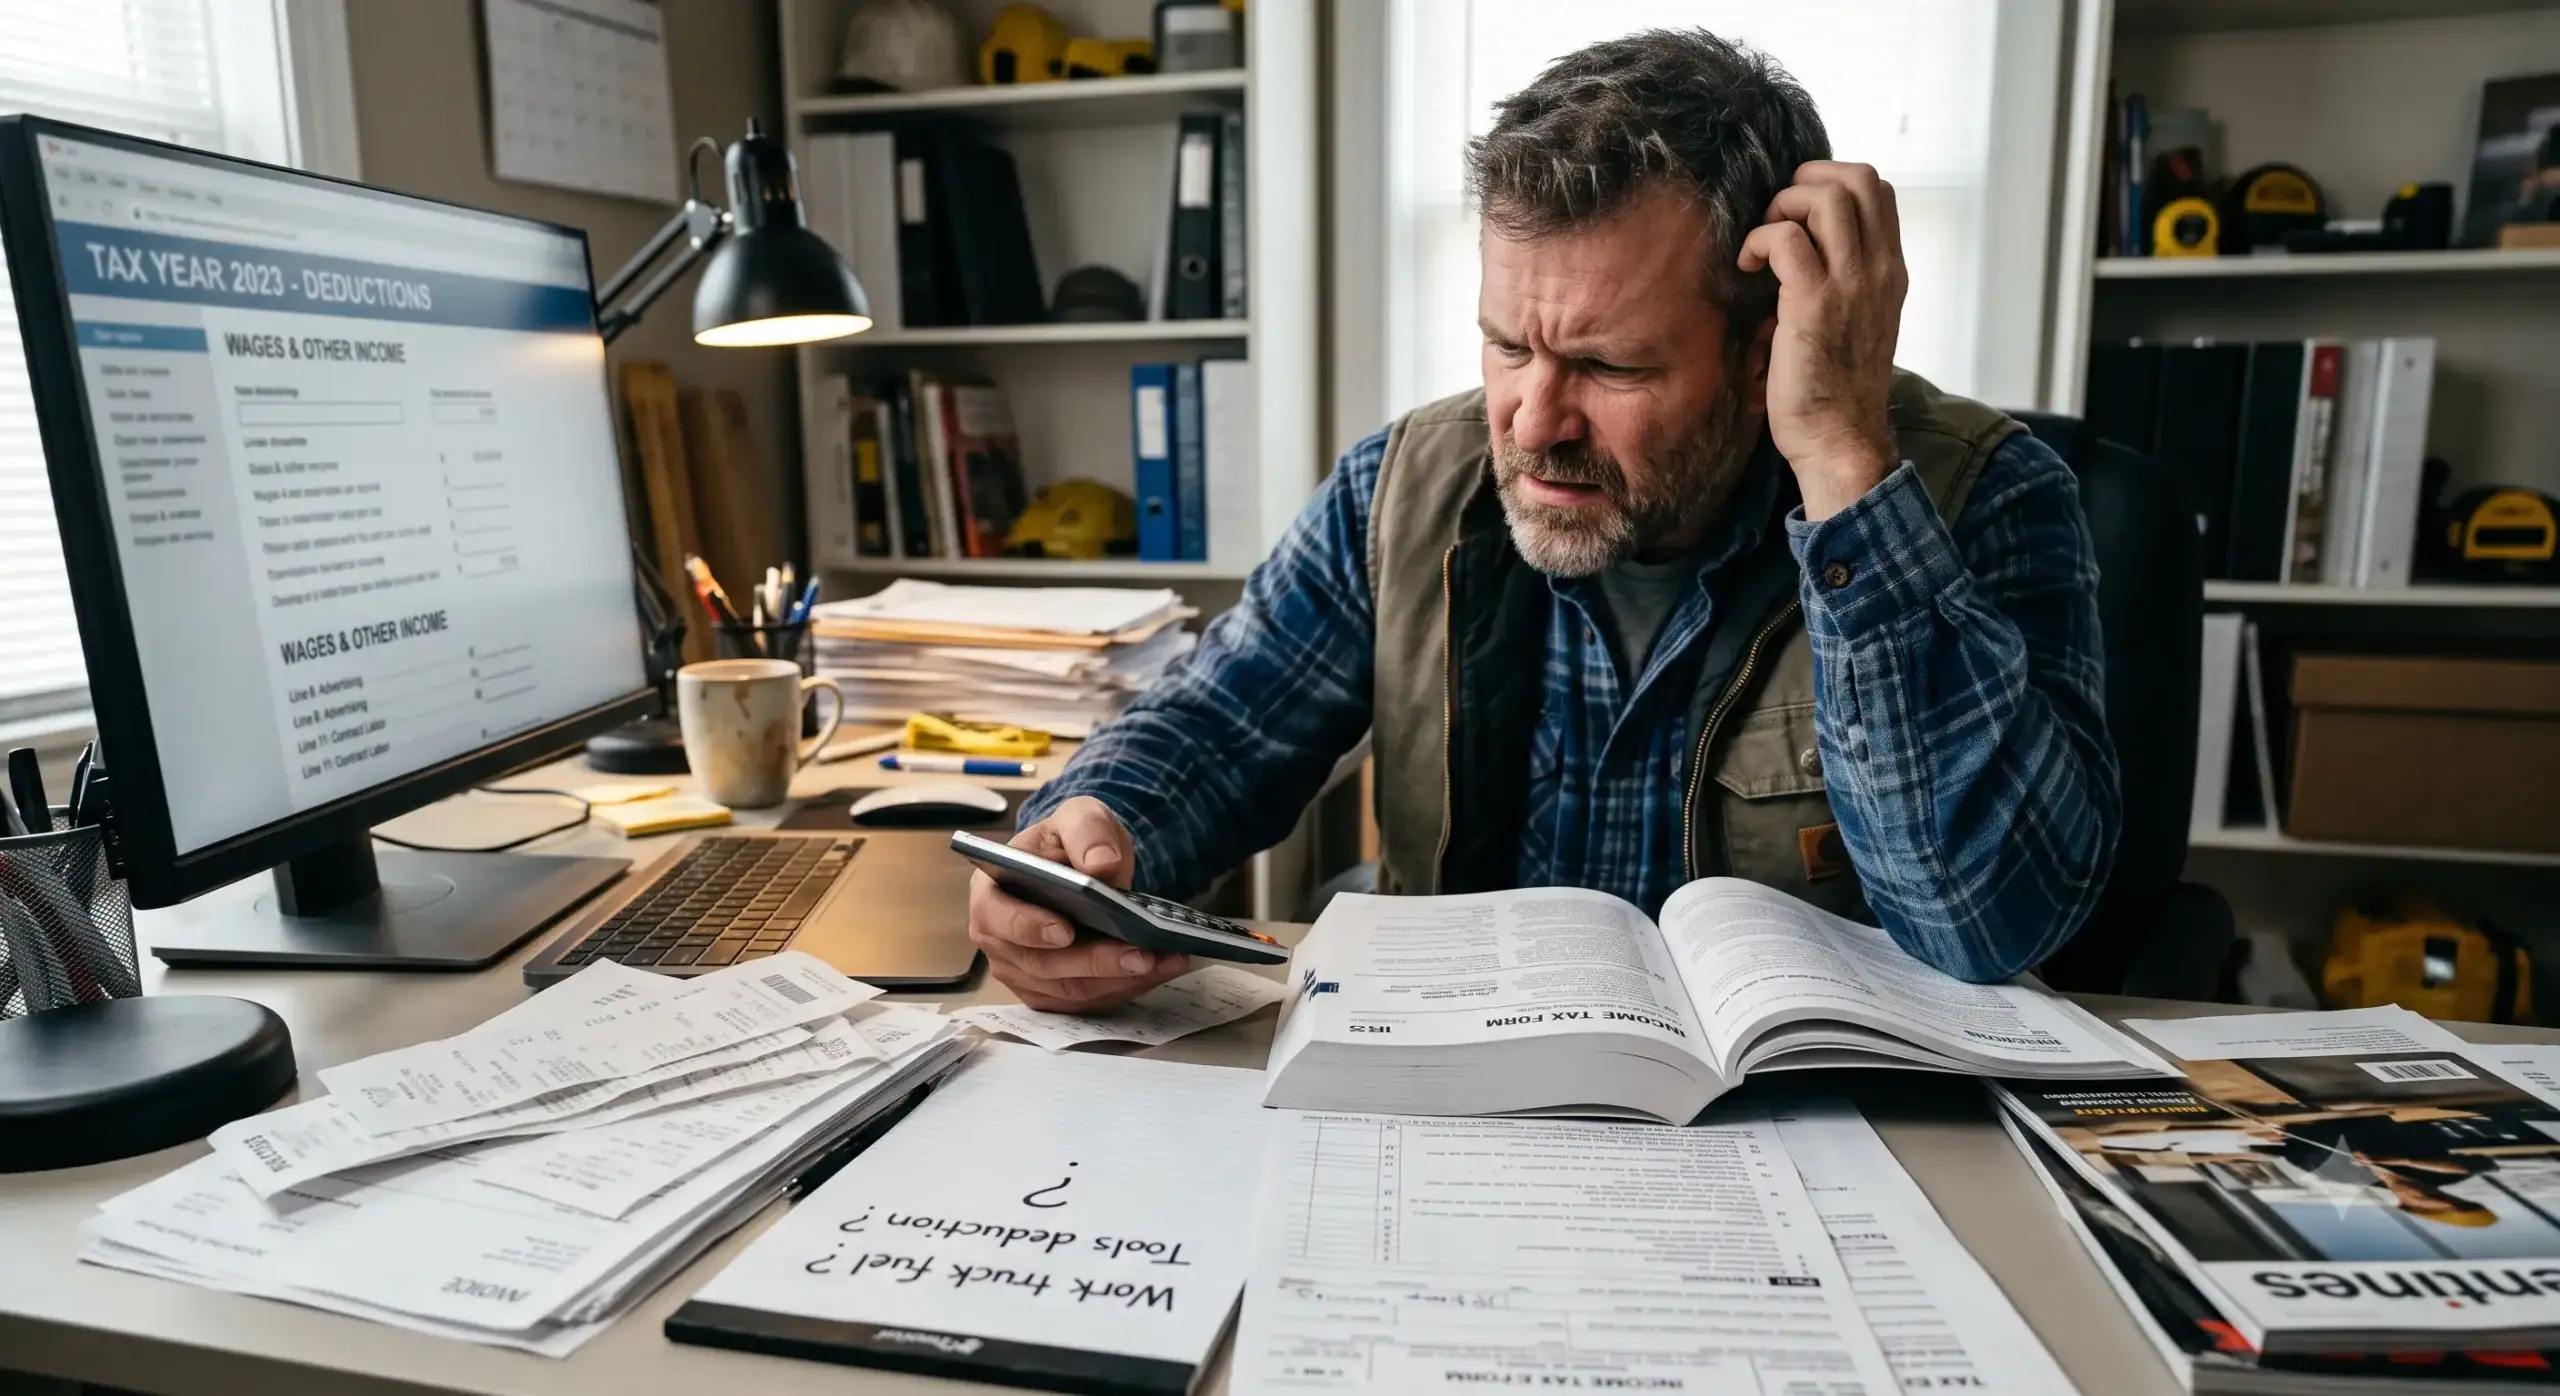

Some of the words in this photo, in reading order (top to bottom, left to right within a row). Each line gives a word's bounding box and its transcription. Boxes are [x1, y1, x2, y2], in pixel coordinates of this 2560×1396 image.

[86, 241, 149, 284] TAX
[149, 250, 227, 292] YEAR
[231, 260, 285, 297] 2023
[302, 269, 432, 311] DEDUCTIONS
[224, 332, 286, 359] WAGES
[288, 337, 301, 360] &
[302, 338, 354, 362] OTHER
[353, 341, 407, 364] INCOME
[280, 633, 336, 666] WAGES
[338, 630, 351, 652] &
[352, 620, 398, 650] OTHER
[399, 609, 448, 639] INCOME
[1486, 1014, 1543, 1028] FORM
[1551, 1010, 1594, 1021] TAX
[1602, 1011, 1687, 1039] INCOME
[1023, 1162, 1079, 1209] ?
[1093, 1236, 1190, 1266] Tools
[948, 1265, 1051, 1297] truck
[1070, 1278, 1173, 1312] Work
[1542, 1376, 1582, 1387] TAX
[1591, 1376, 1683, 1389] INCOME
[1938, 1376, 1989, 1389] TAX
